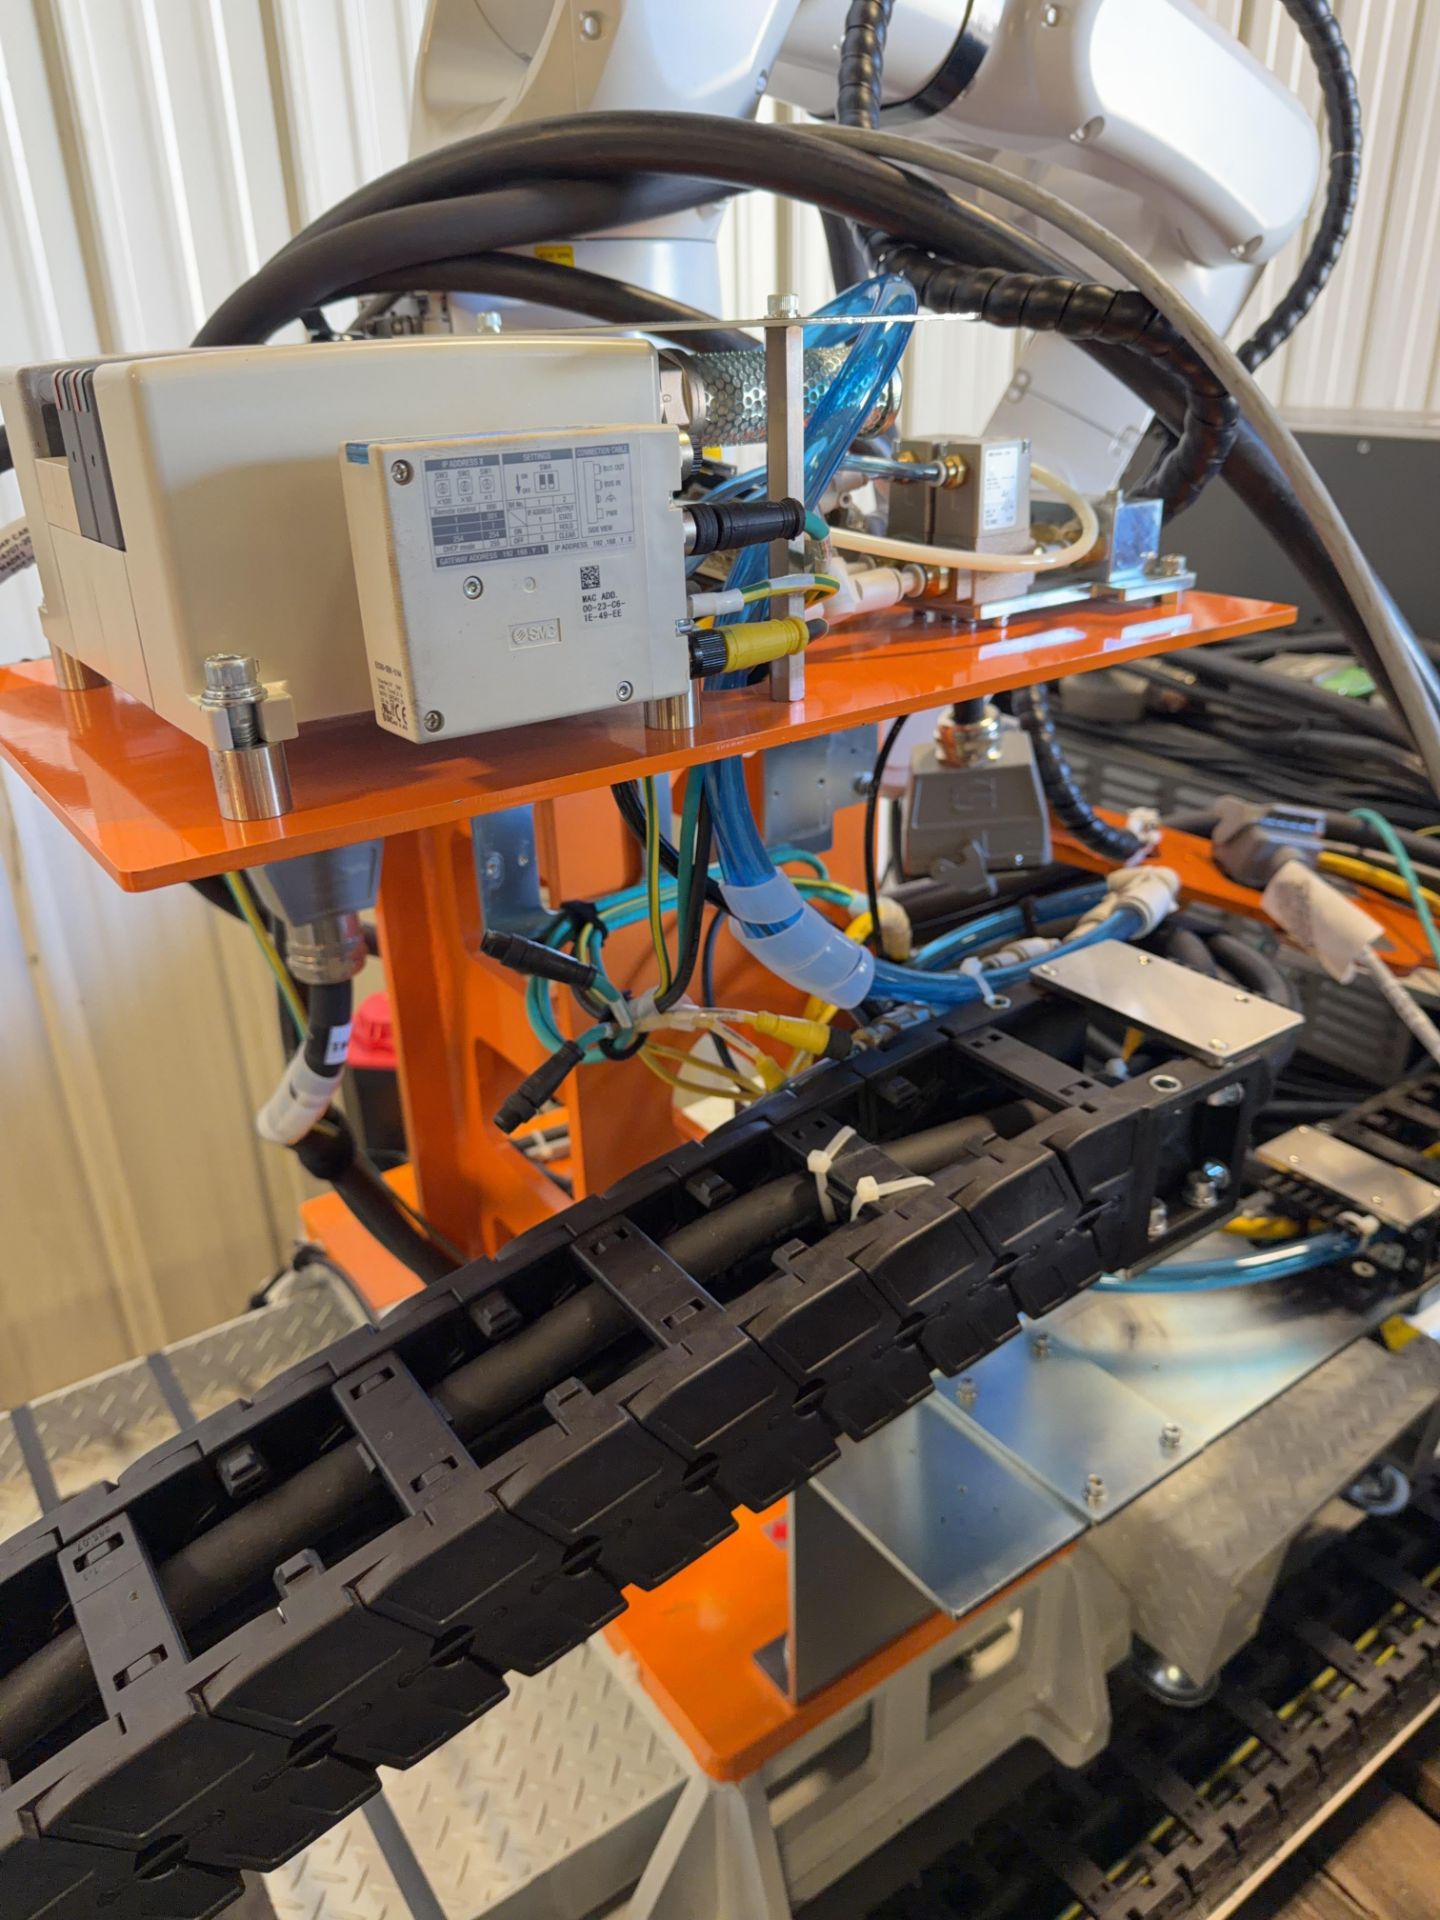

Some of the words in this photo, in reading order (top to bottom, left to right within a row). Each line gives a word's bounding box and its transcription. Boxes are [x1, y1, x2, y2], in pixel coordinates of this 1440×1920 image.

[448, 458, 478, 467] ADDRESS
[561, 540, 588, 550] ADDRESS
[438, 555, 468, 565] GATEWAY
[468, 551, 498, 561] ADDRESS
[582, 594, 597, 603] MAC
[601, 591, 618, 600] ADD.
[582, 600, 626, 613] 00-23-C6-
[583, 609, 622, 622] 1E-49-EE
